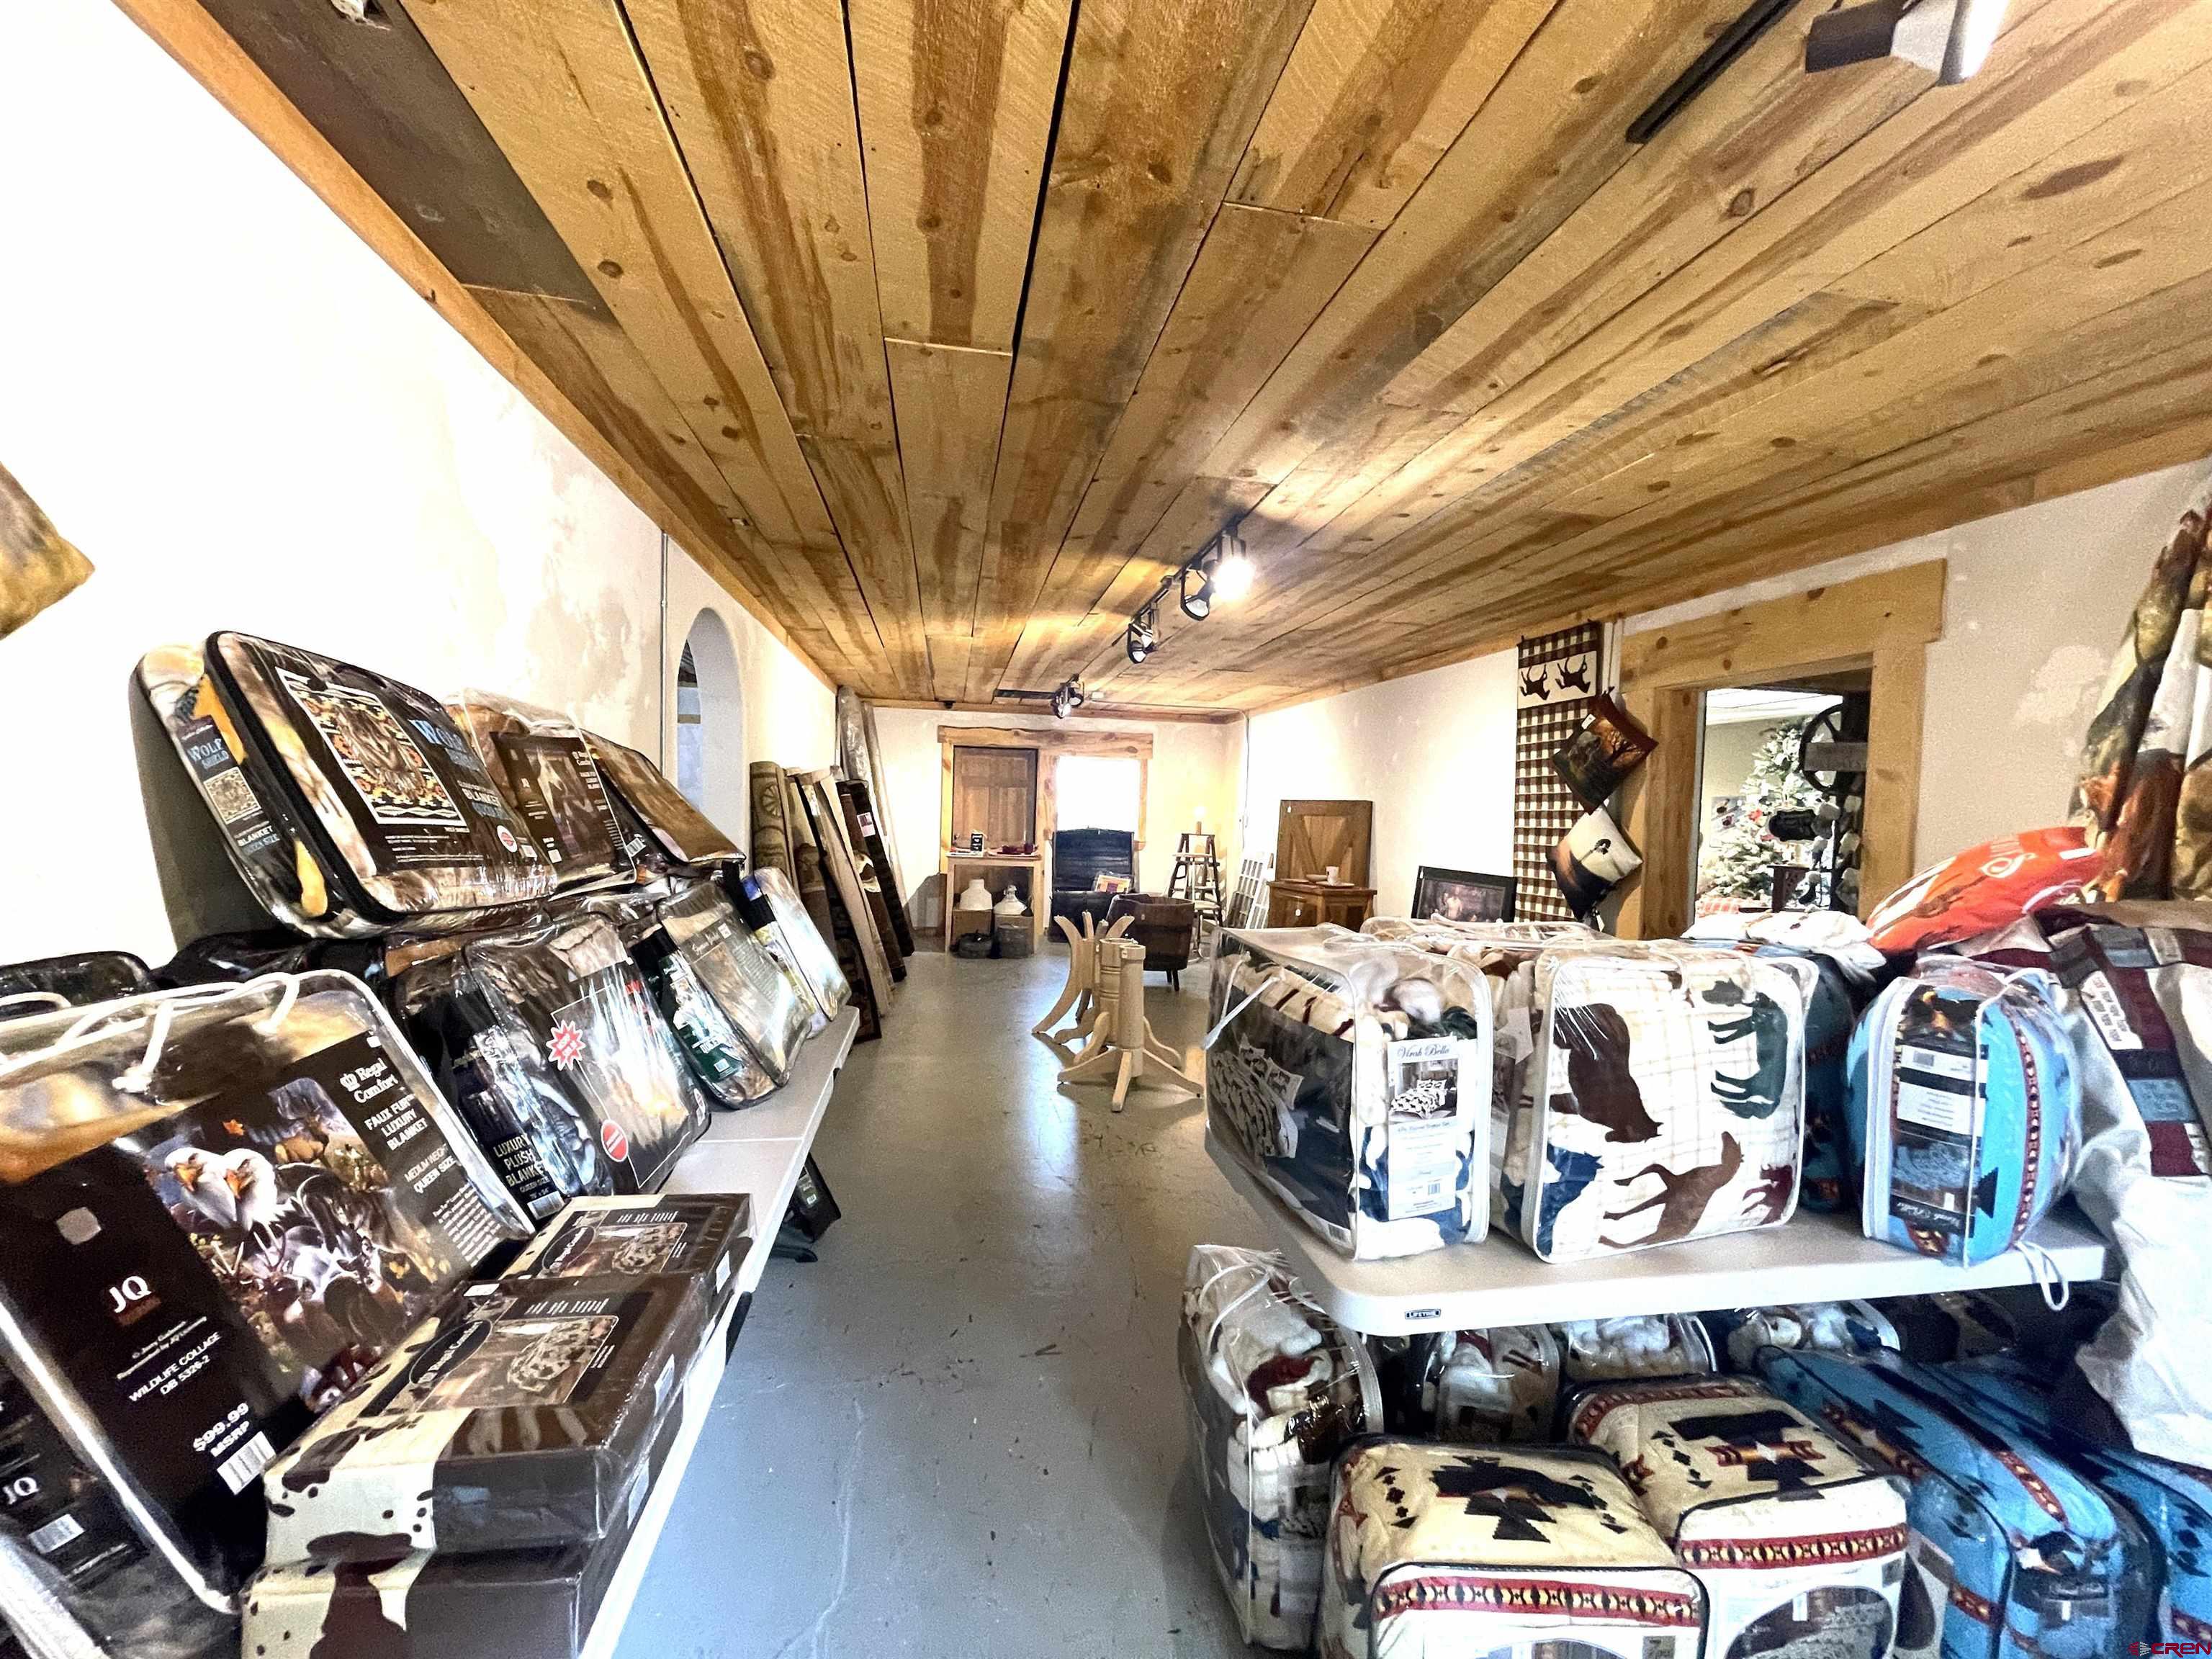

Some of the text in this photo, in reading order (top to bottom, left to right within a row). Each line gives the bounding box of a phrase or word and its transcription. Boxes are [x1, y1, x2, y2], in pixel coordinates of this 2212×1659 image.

[187, 738, 223, 763] WOLF
[237, 825, 274, 847] BLANKET
[355, 1057, 387, 1081] Regal
[354, 1074, 399, 1104] Comfort
[364, 1102, 393, 1130] FAUX
[380, 1108, 418, 1137] LUXURY
[387, 1118, 428, 1151] BLANKET
[493, 1133, 531, 1158] LUXURY
[404, 1159, 430, 1182] MEDIUM
[504, 1148, 536, 1171] PLUSH
[413, 1155, 457, 1194] QUEEN SIZE
[109, 1275, 152, 1313] JQ
[128, 1331, 222, 1403] WILDLIFE COLLAGE
[193, 1403, 249, 1452] $99.99
[210, 1420, 250, 1457] MSRP
[3, 1476, 40, 1505] JQ
